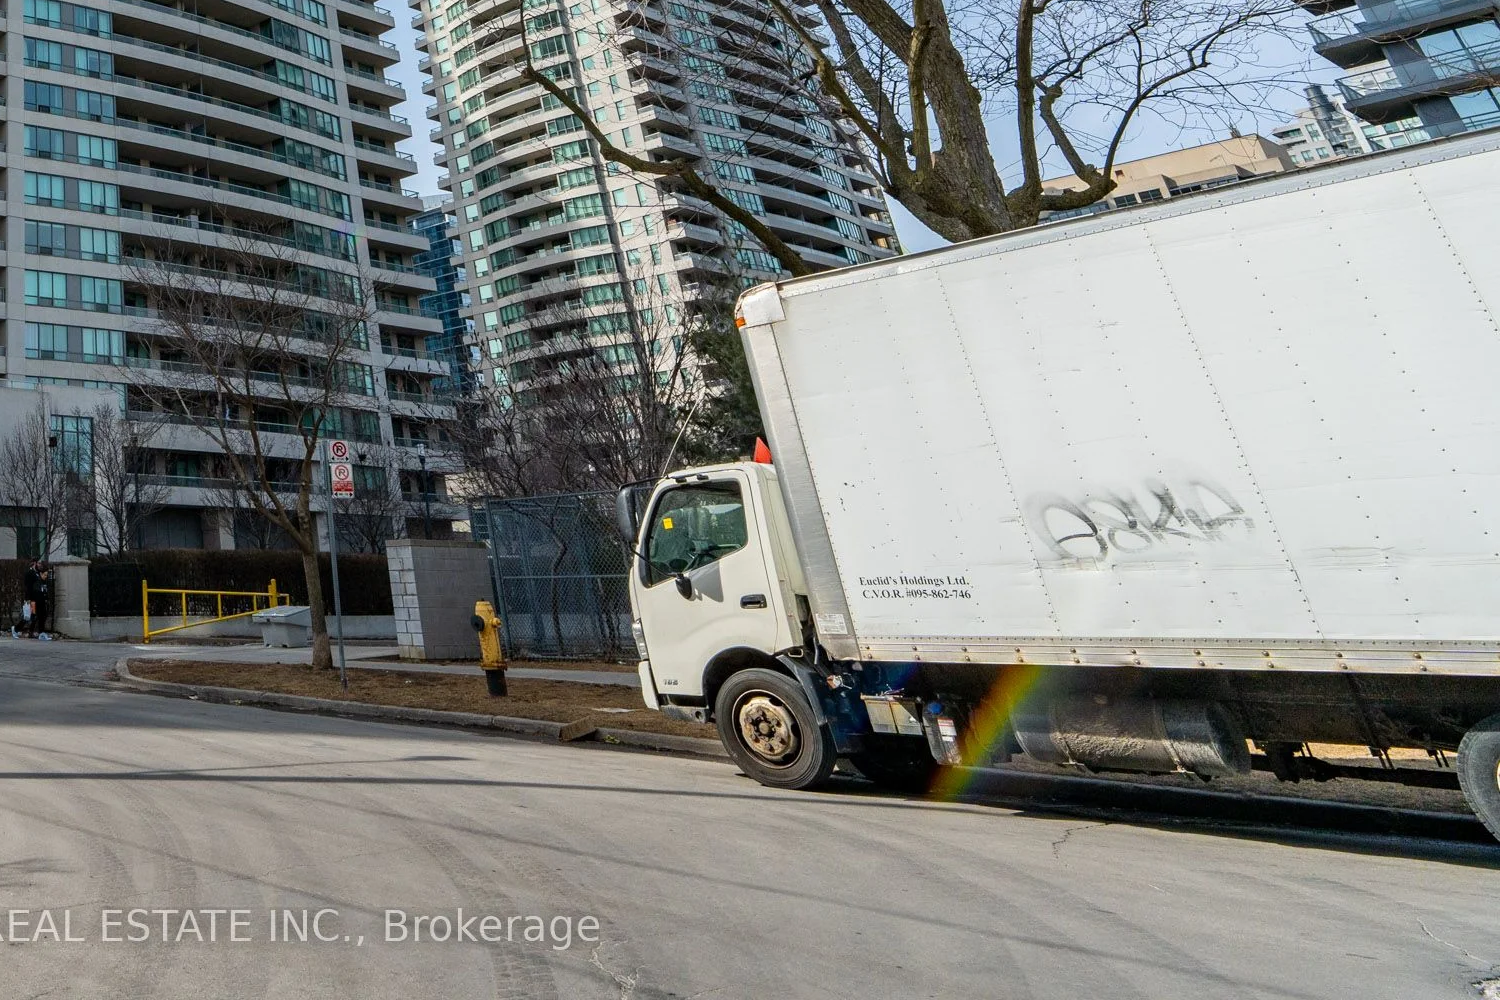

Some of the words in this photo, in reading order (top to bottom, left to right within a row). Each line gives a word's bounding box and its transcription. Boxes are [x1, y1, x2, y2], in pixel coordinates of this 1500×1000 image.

[859, 576, 898, 586] Euclid's
[900, 576, 944, 587] Holdings
[947, 576, 969, 586] Ltd.
[862, 589, 904, 599] C.V.O.R.
[906, 589, 971, 599] #095-862-746
